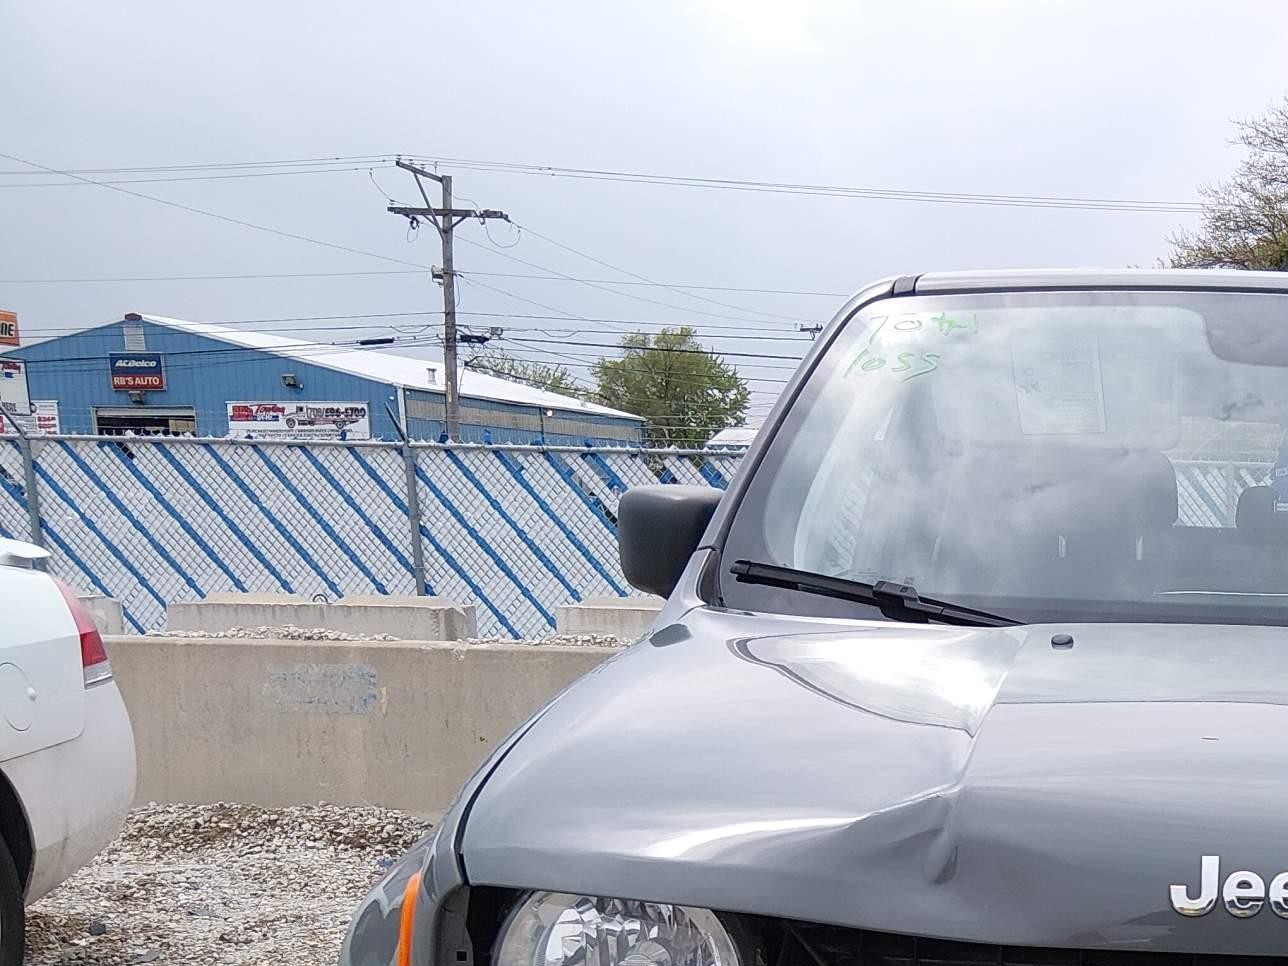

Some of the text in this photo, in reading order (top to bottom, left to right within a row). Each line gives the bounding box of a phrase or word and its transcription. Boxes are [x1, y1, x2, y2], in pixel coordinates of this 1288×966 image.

[114, 359, 158, 367] ACDelco
[113, 376, 160, 385] RB'S AUTO
